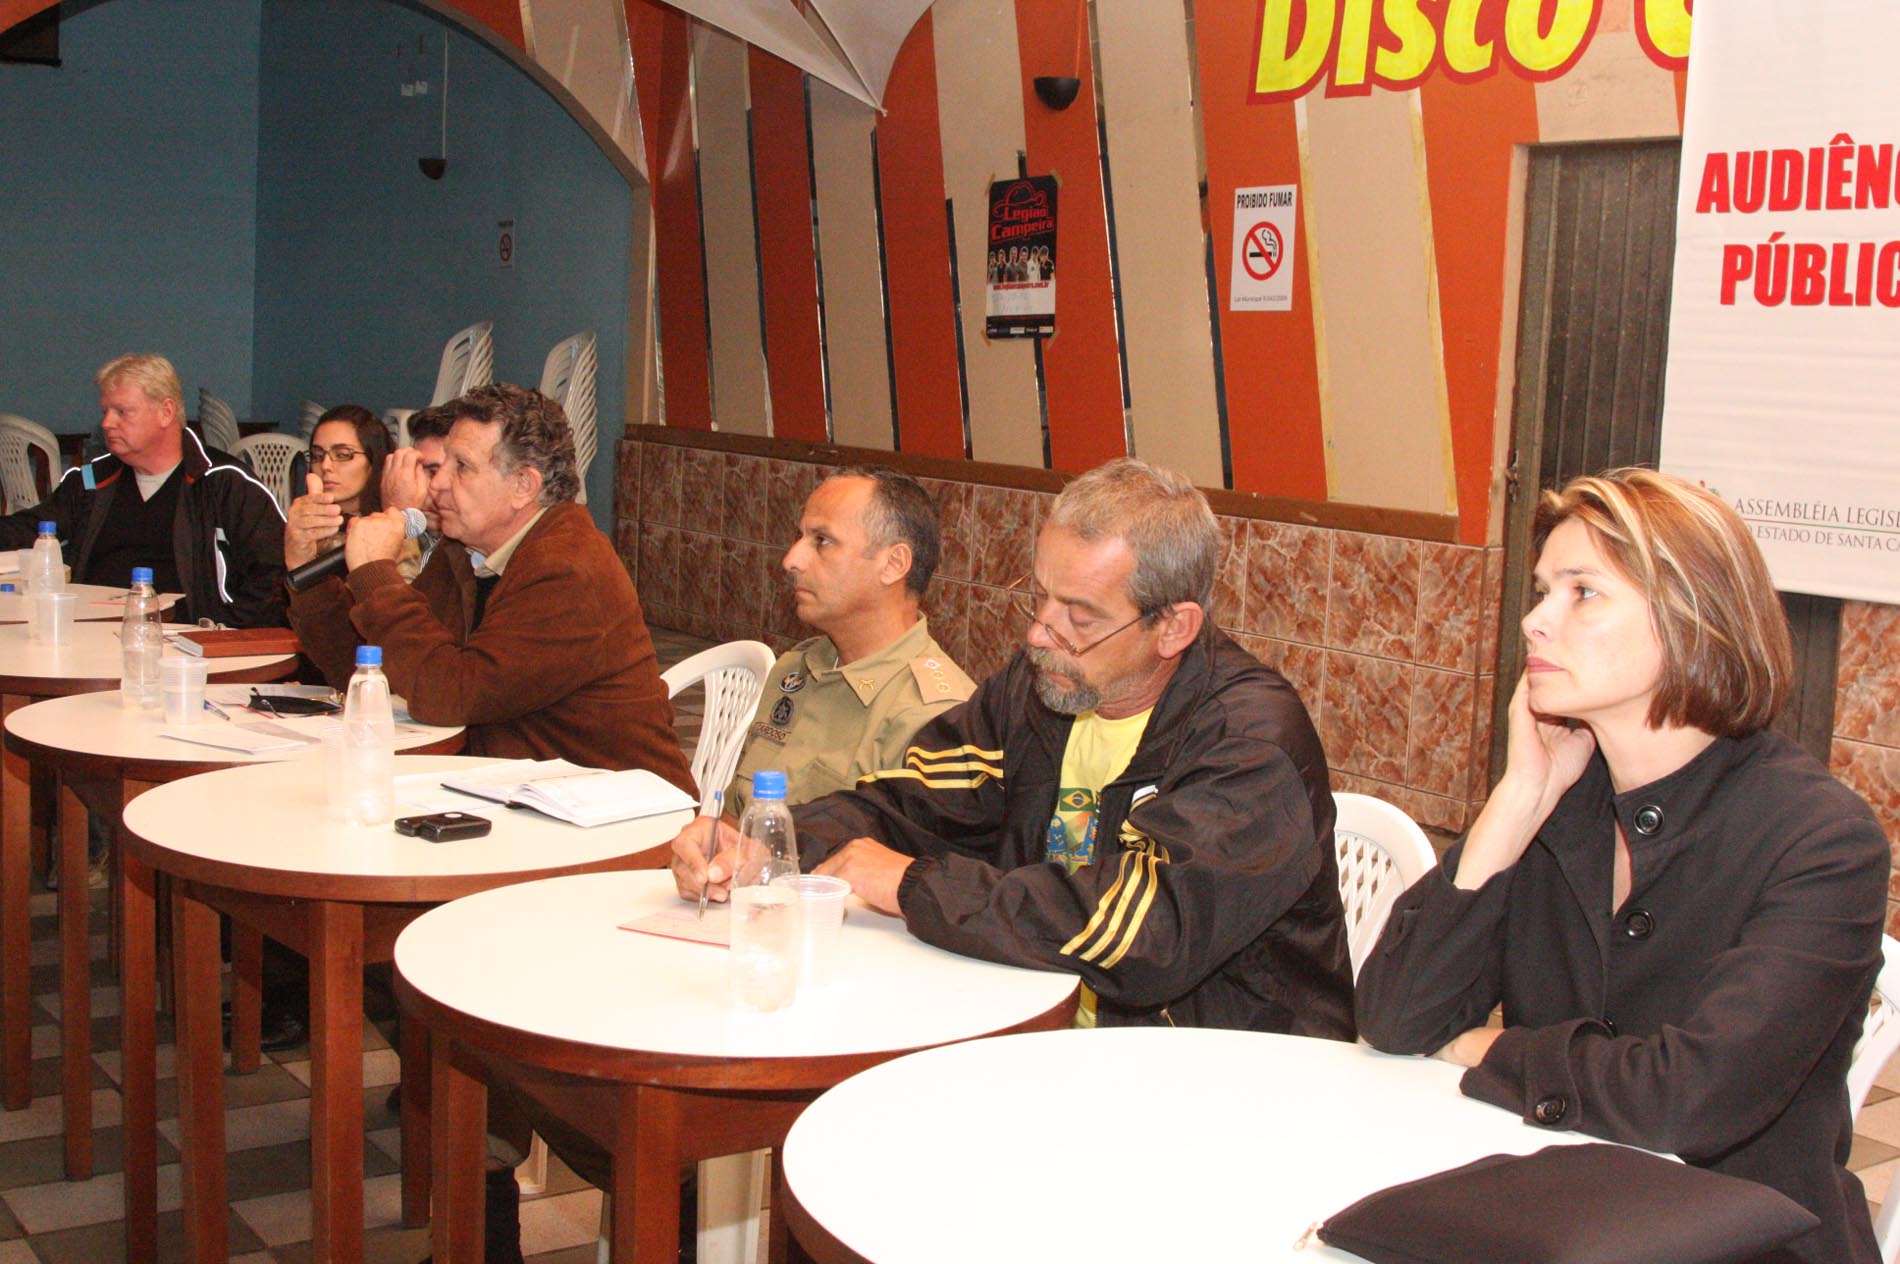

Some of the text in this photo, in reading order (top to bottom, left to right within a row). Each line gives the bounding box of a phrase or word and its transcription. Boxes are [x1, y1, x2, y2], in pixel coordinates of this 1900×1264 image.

[1695, 132, 1900, 214] AUDIÊN
[1236, 191, 1293, 209] PROIBIDO FUMAR
[991, 219, 1054, 240] Campeira
[1735, 497, 1840, 523] ASSEMBLÉIA
[1757, 525, 1811, 544] ESTADO
[1815, 532, 1833, 545] DE
[1837, 532, 1882, 550] SANTA
